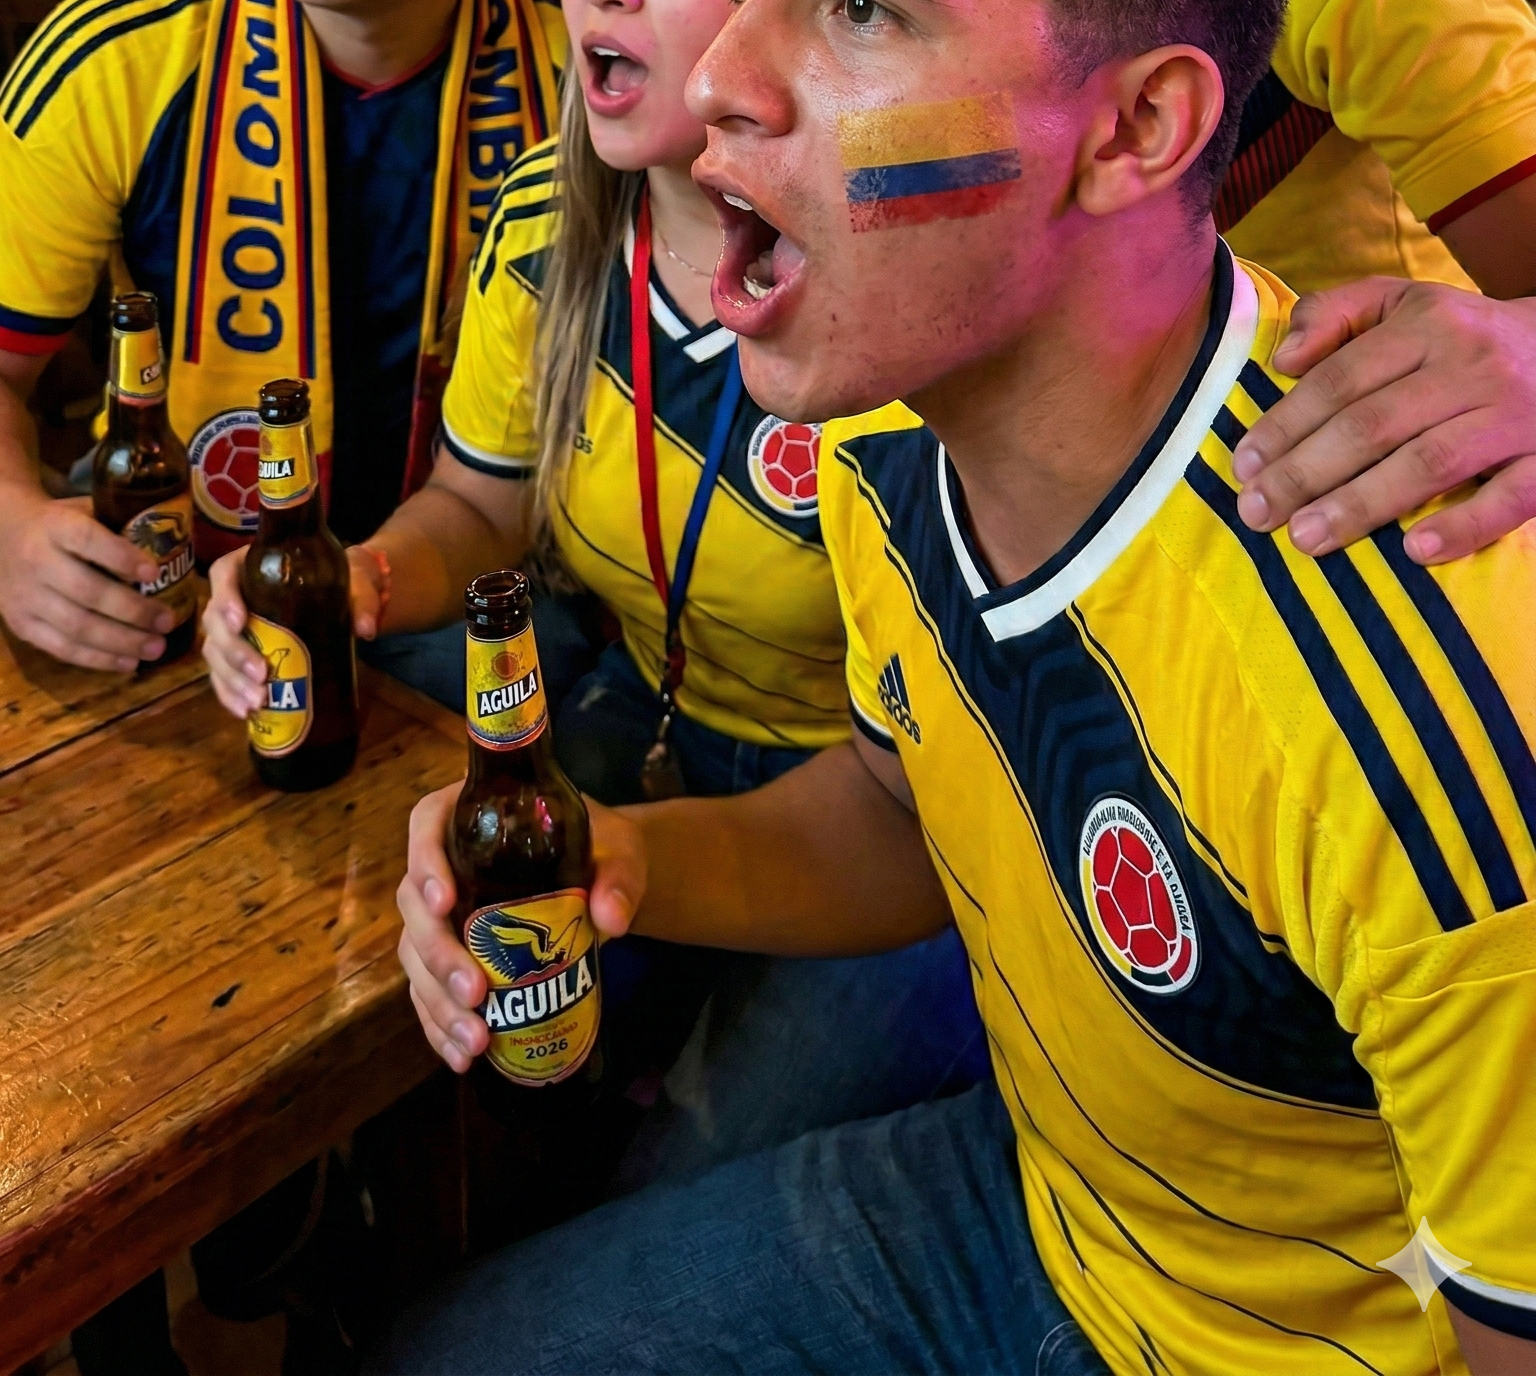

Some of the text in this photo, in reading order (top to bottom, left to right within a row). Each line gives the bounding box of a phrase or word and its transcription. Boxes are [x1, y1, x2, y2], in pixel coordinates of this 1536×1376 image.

[480, 672, 537, 715] AGUILA
[485, 955, 593, 1027] AGUILA
[525, 1038, 569, 1060] 2026
